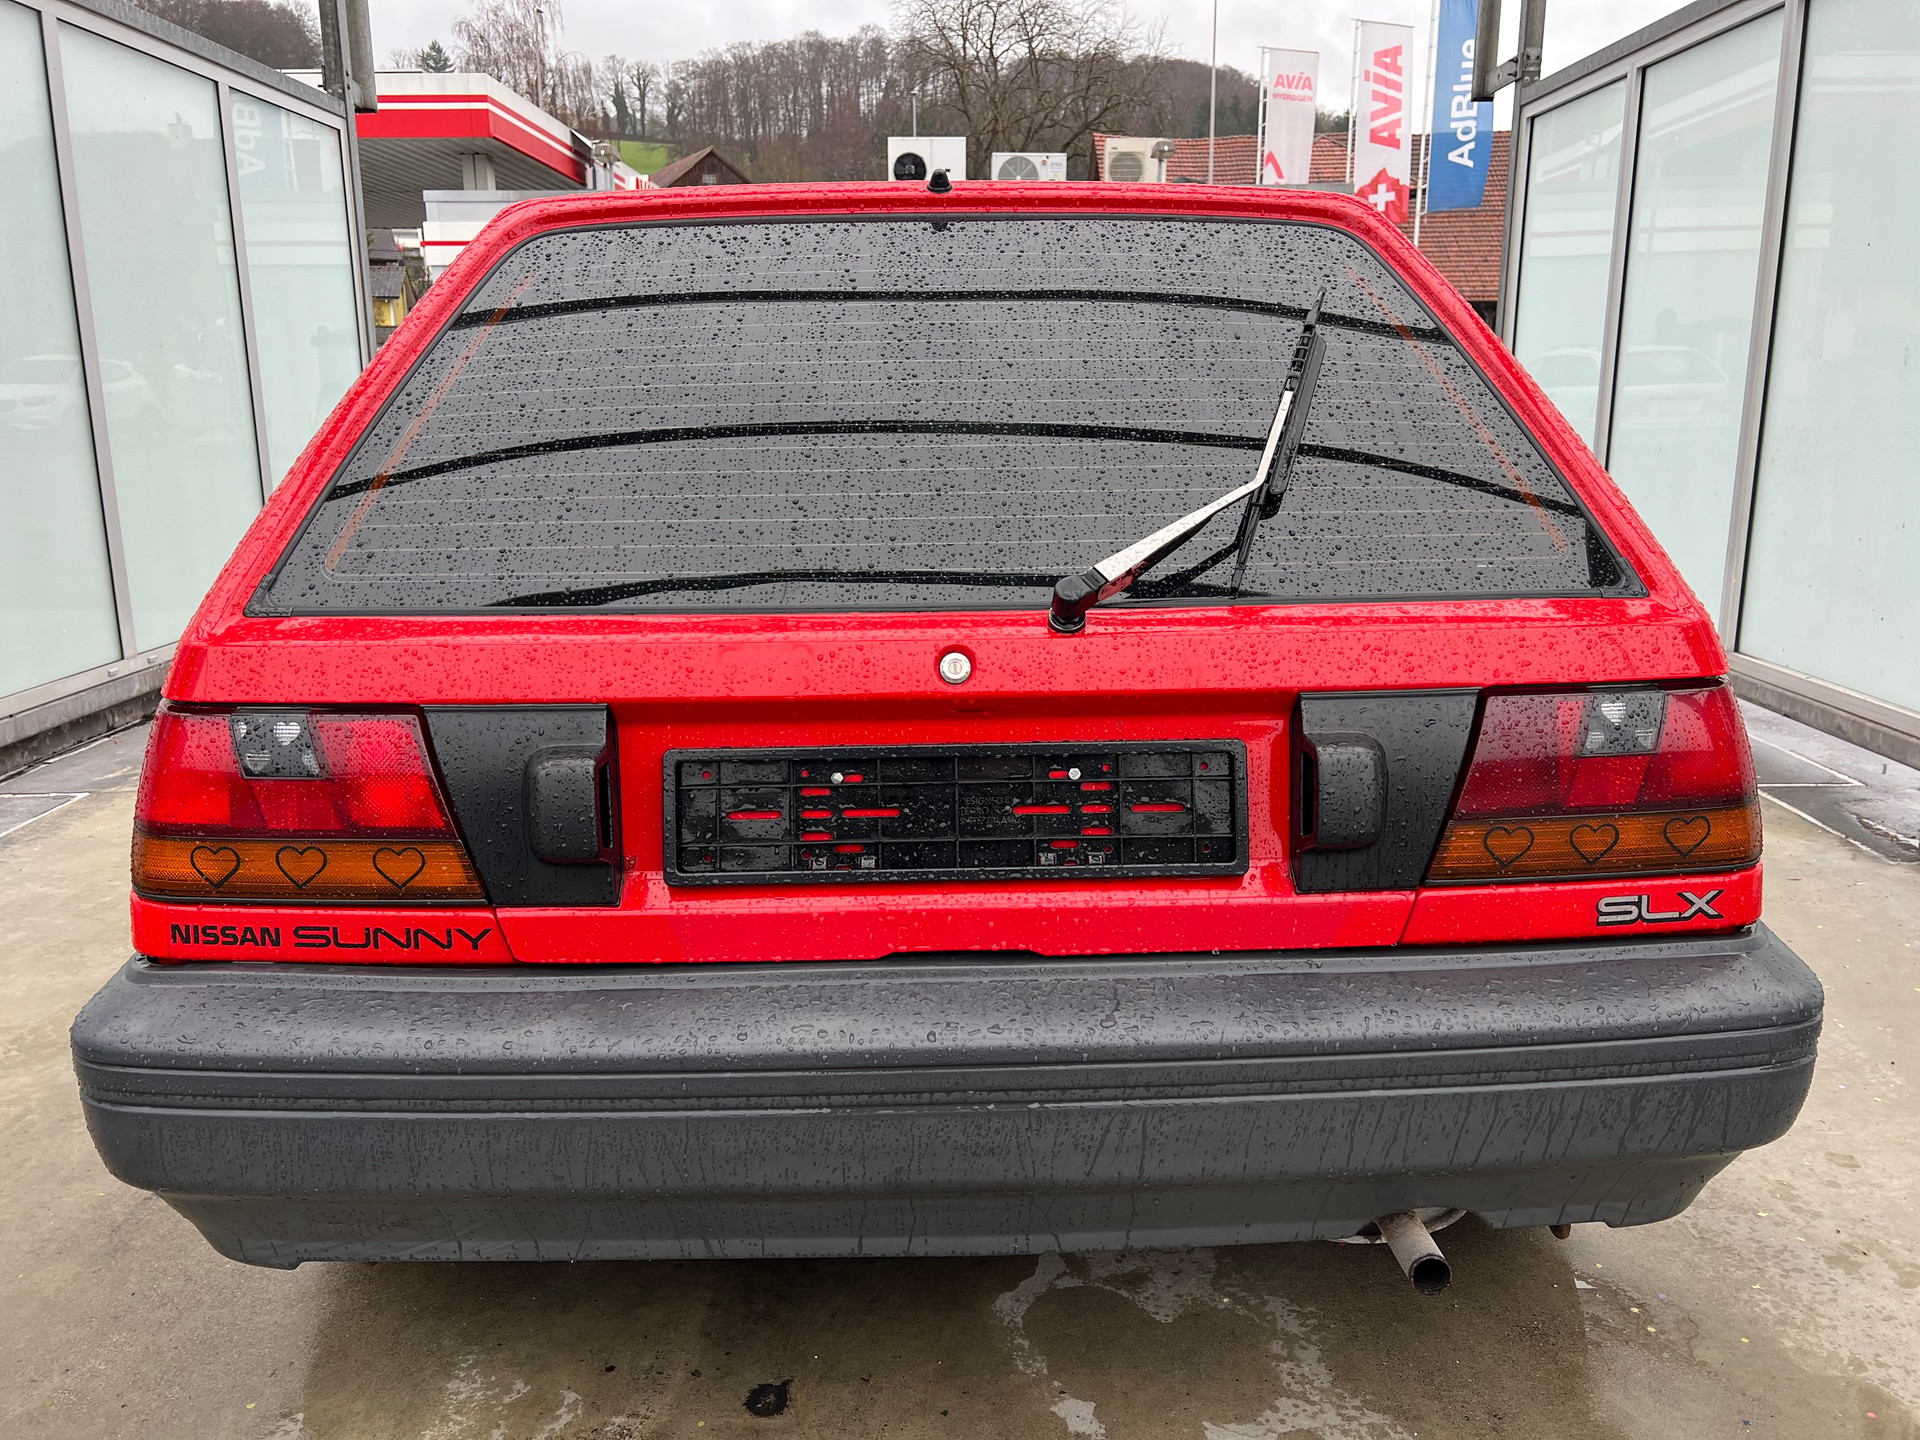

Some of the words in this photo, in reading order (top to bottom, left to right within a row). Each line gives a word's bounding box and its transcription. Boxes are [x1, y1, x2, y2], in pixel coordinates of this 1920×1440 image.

[1272, 92, 1313, 102] HYDROGEN
[1447, 38, 1478, 169] AdBlue
[1596, 889, 1725, 926] SLX
[170, 923, 281, 948] NISSAN
[293, 925, 492, 950] SUNNY
